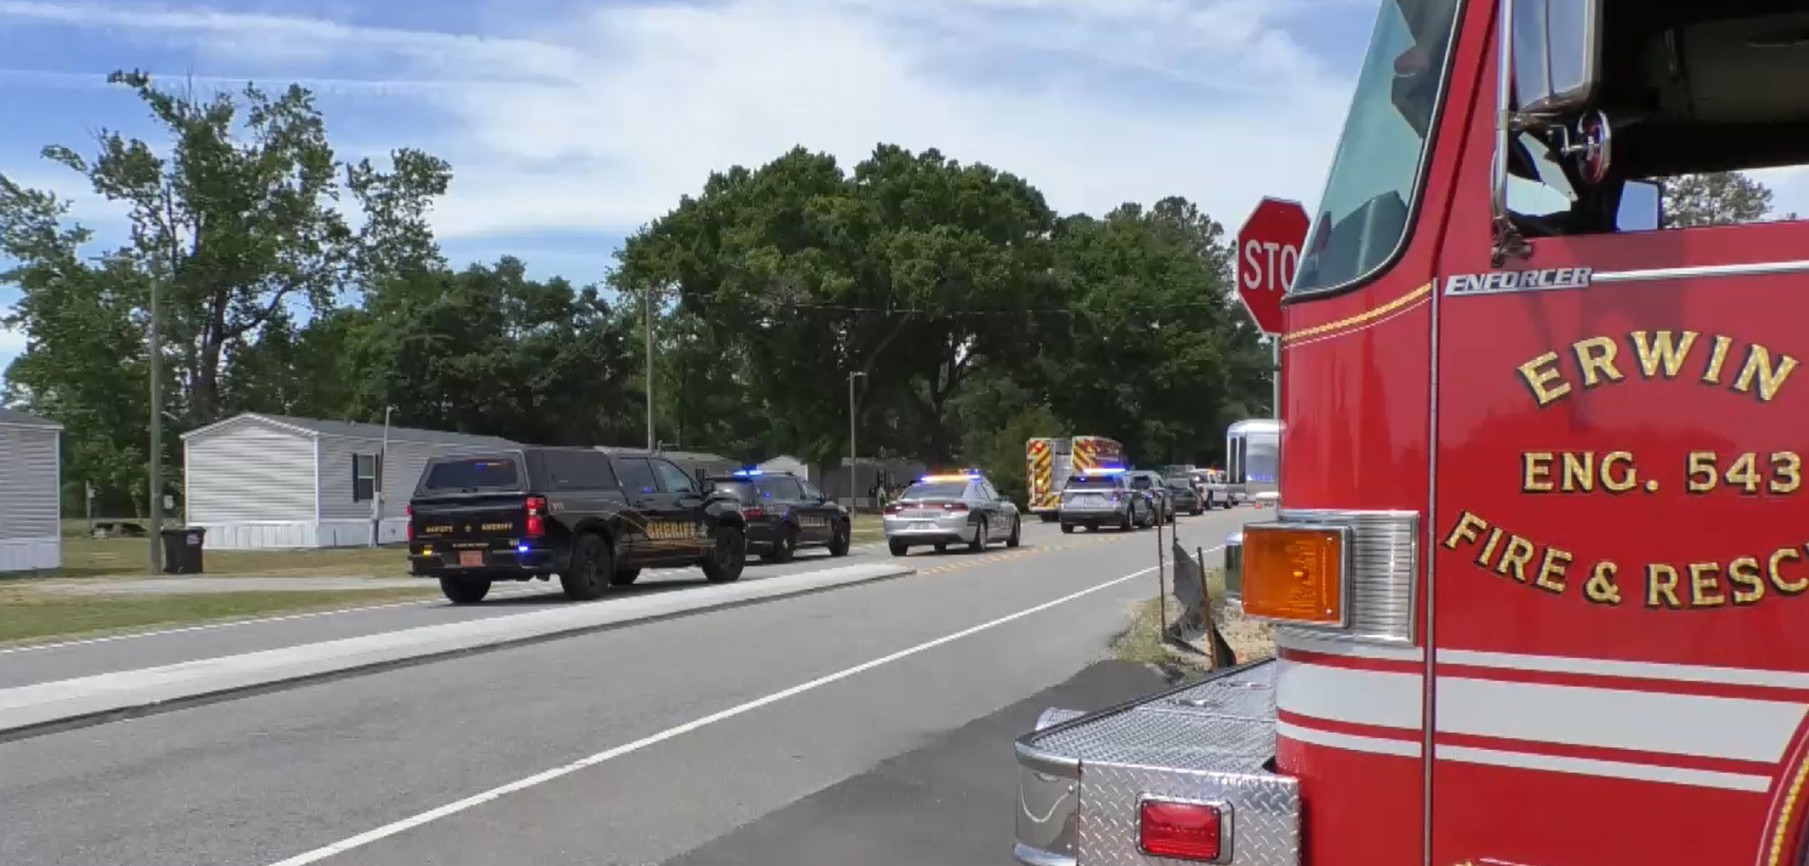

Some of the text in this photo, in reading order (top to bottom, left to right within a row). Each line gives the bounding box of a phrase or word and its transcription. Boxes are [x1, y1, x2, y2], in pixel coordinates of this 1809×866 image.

[1243, 239, 1299, 293] STO
[1445, 267, 1592, 294] ENFORCER
[1517, 329, 1800, 406] ERWIN
[1522, 450, 1802, 493] ENG. 543
[646, 522, 697, 539] SHERIFF
[1444, 511, 1809, 607] FIRE & RESC
